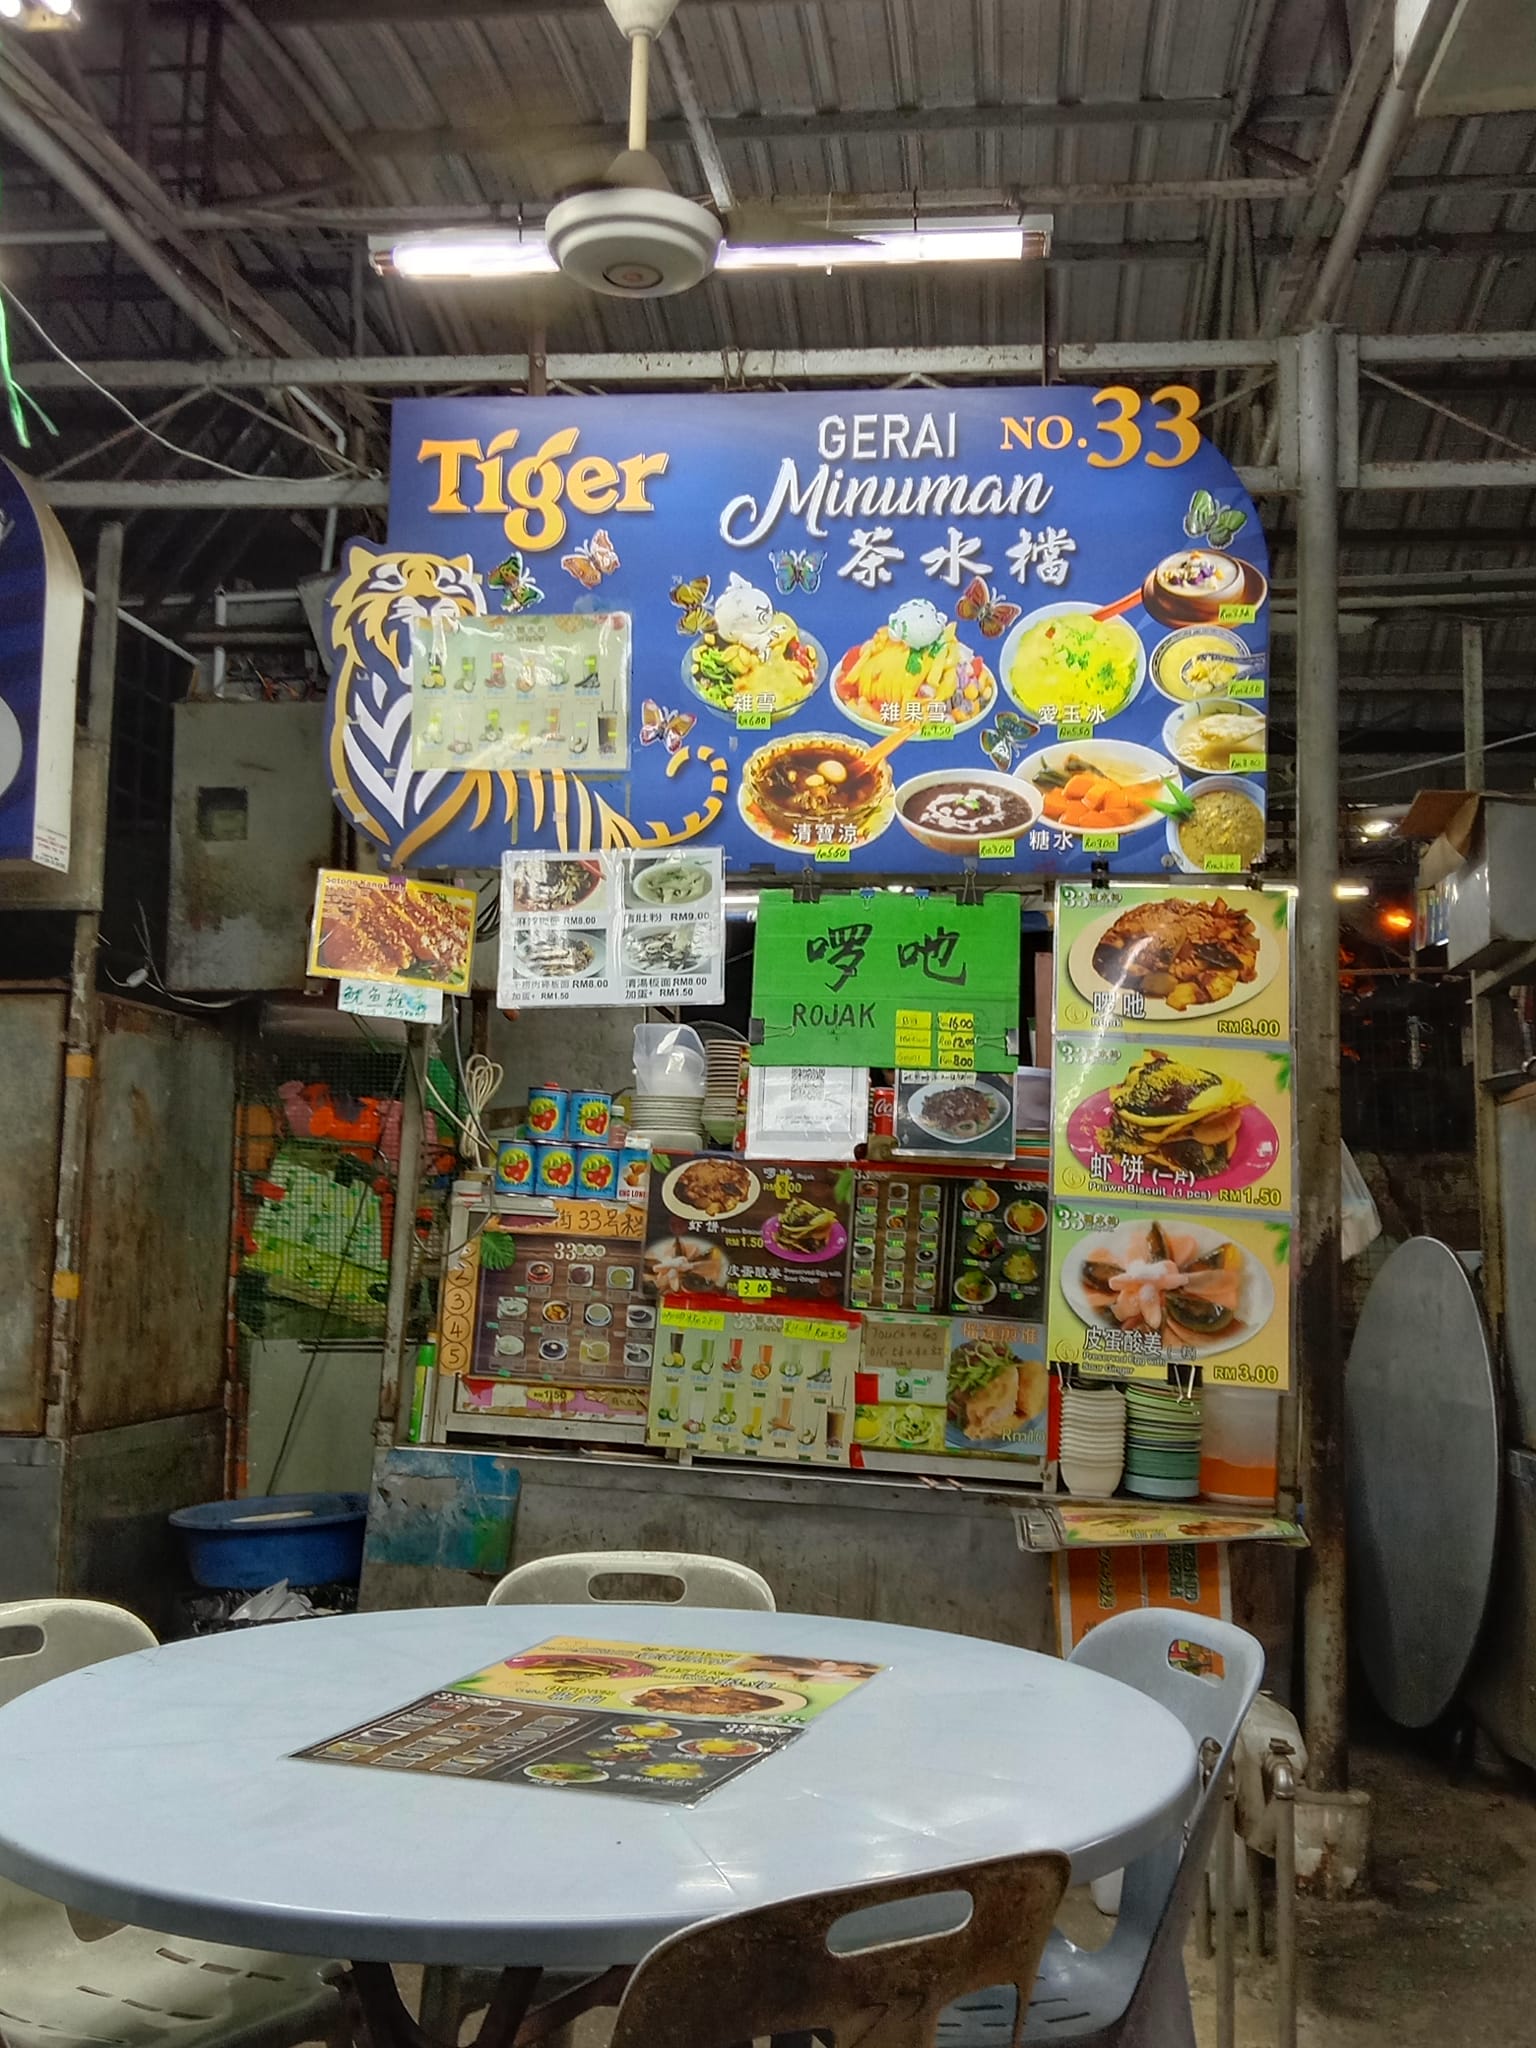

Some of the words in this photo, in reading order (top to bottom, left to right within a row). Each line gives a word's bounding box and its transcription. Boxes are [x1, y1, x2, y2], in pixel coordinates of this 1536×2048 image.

[817, 411, 957, 460] GERAI
[417, 427, 670, 551] Tiger
[719, 456, 1055, 548] Minuman
[837, 526, 1077, 587] 茶水檔
[732, 693, 776, 713] 雜雪
[880, 702, 948, 723] 雜果雪
[1038, 703, 1107, 724] 愛玉冰
[1029, 829, 1074, 851] 糖水
[670, 911, 710, 921] RM9.00
[572, 979, 609, 989] RM8.00
[792, 1002, 876, 1029] ROJAK
[1217, 1018, 1280, 1037] RM8.00
[1090, 1152, 1144, 1183] 虾饼
[1088, 1181, 1125, 1193] Prawn
[1127, 1184, 1166, 1196] Biscuit
[1186, 1190, 1212, 1200] pcs)
[1218, 1187, 1282, 1206] RM1.50
[1058, 1209, 1084, 1231] 33
[553, 1242, 577, 1260] 33
[453, 1294, 465, 1309] 3
[450, 1324, 462, 1338] 4
[1084, 1325, 1162, 1356] 皮蛋酸姜
[450, 1348, 460, 1362] 5
[1213, 1364, 1279, 1384] RM3.00
